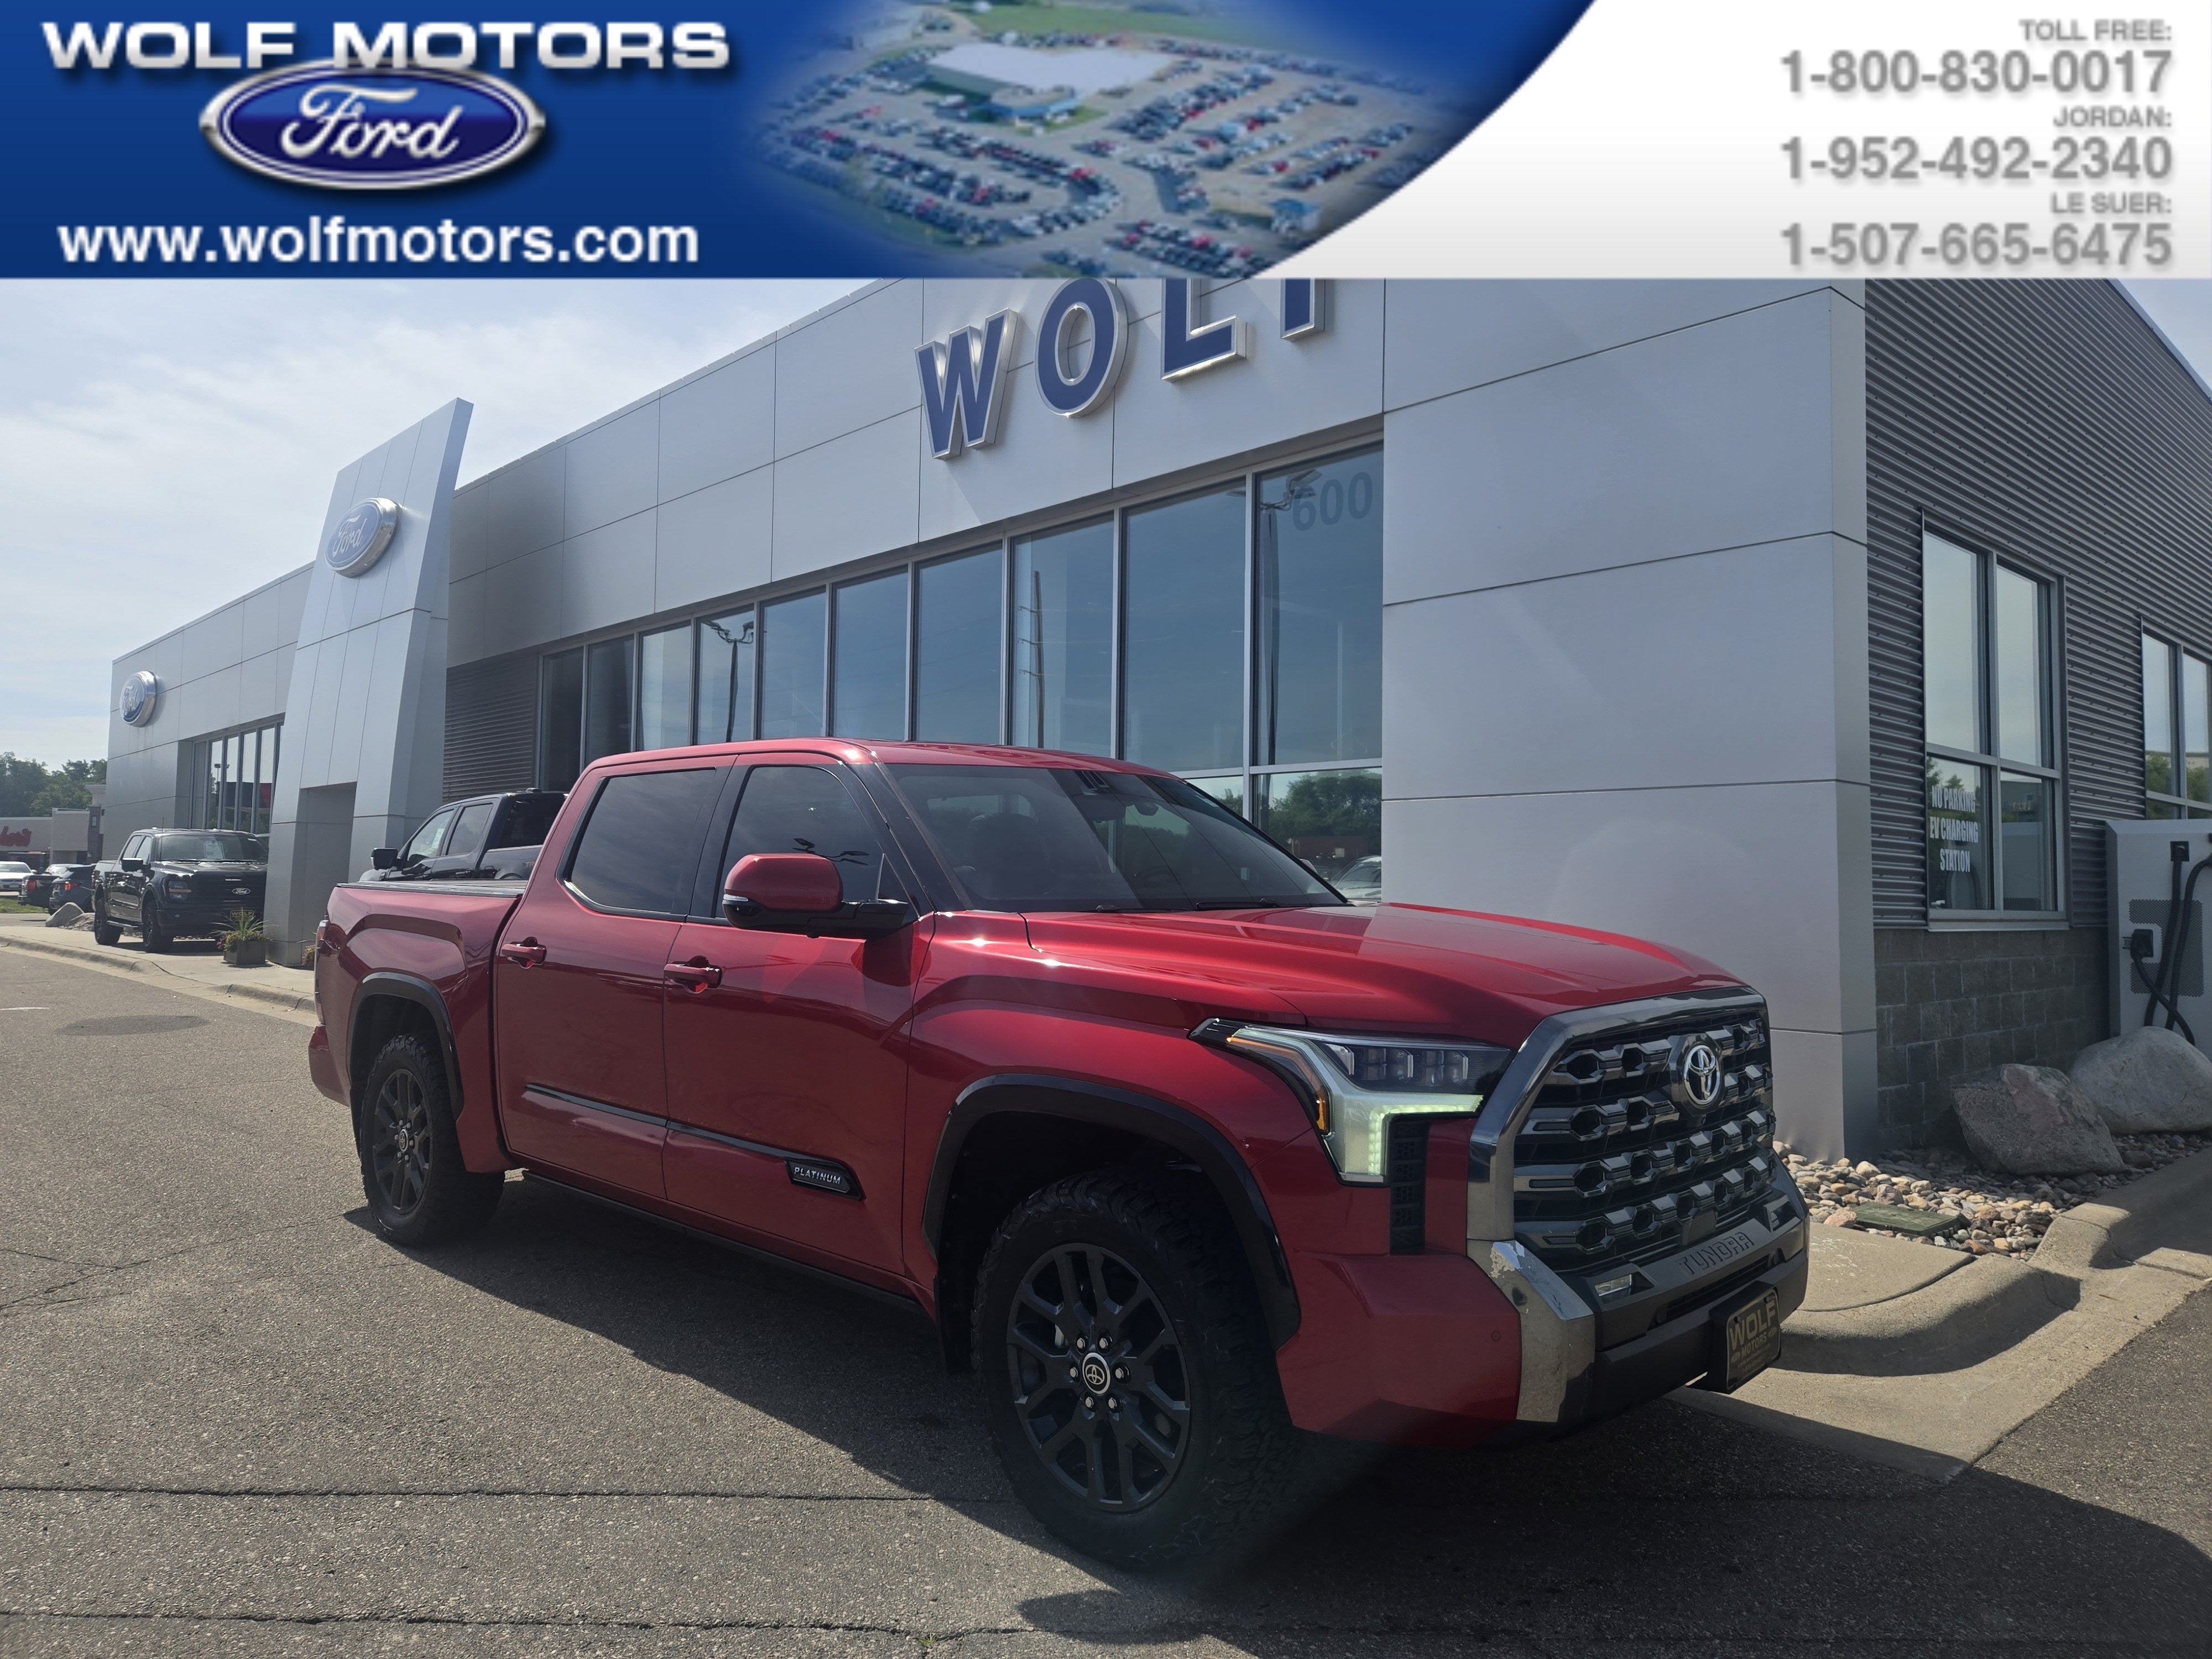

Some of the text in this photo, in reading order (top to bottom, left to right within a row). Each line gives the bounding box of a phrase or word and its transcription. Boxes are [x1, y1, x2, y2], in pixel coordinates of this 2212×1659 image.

[1293, 472, 1373, 531] 600
[332, 514, 368, 557] Ford
[122, 685, 138, 716] Ford
[1932, 785, 1976, 813] NO PARKING
[1929, 816, 1979, 843] EV CHARGING
[1940, 848, 1970, 873] STATION
[794, 1167, 841, 1185] PLATINUM
[1674, 1232, 1755, 1275] TUNDRA
[1729, 1300, 1776, 1350] WOLF
[1741, 1332, 1767, 1358] MOTORS
